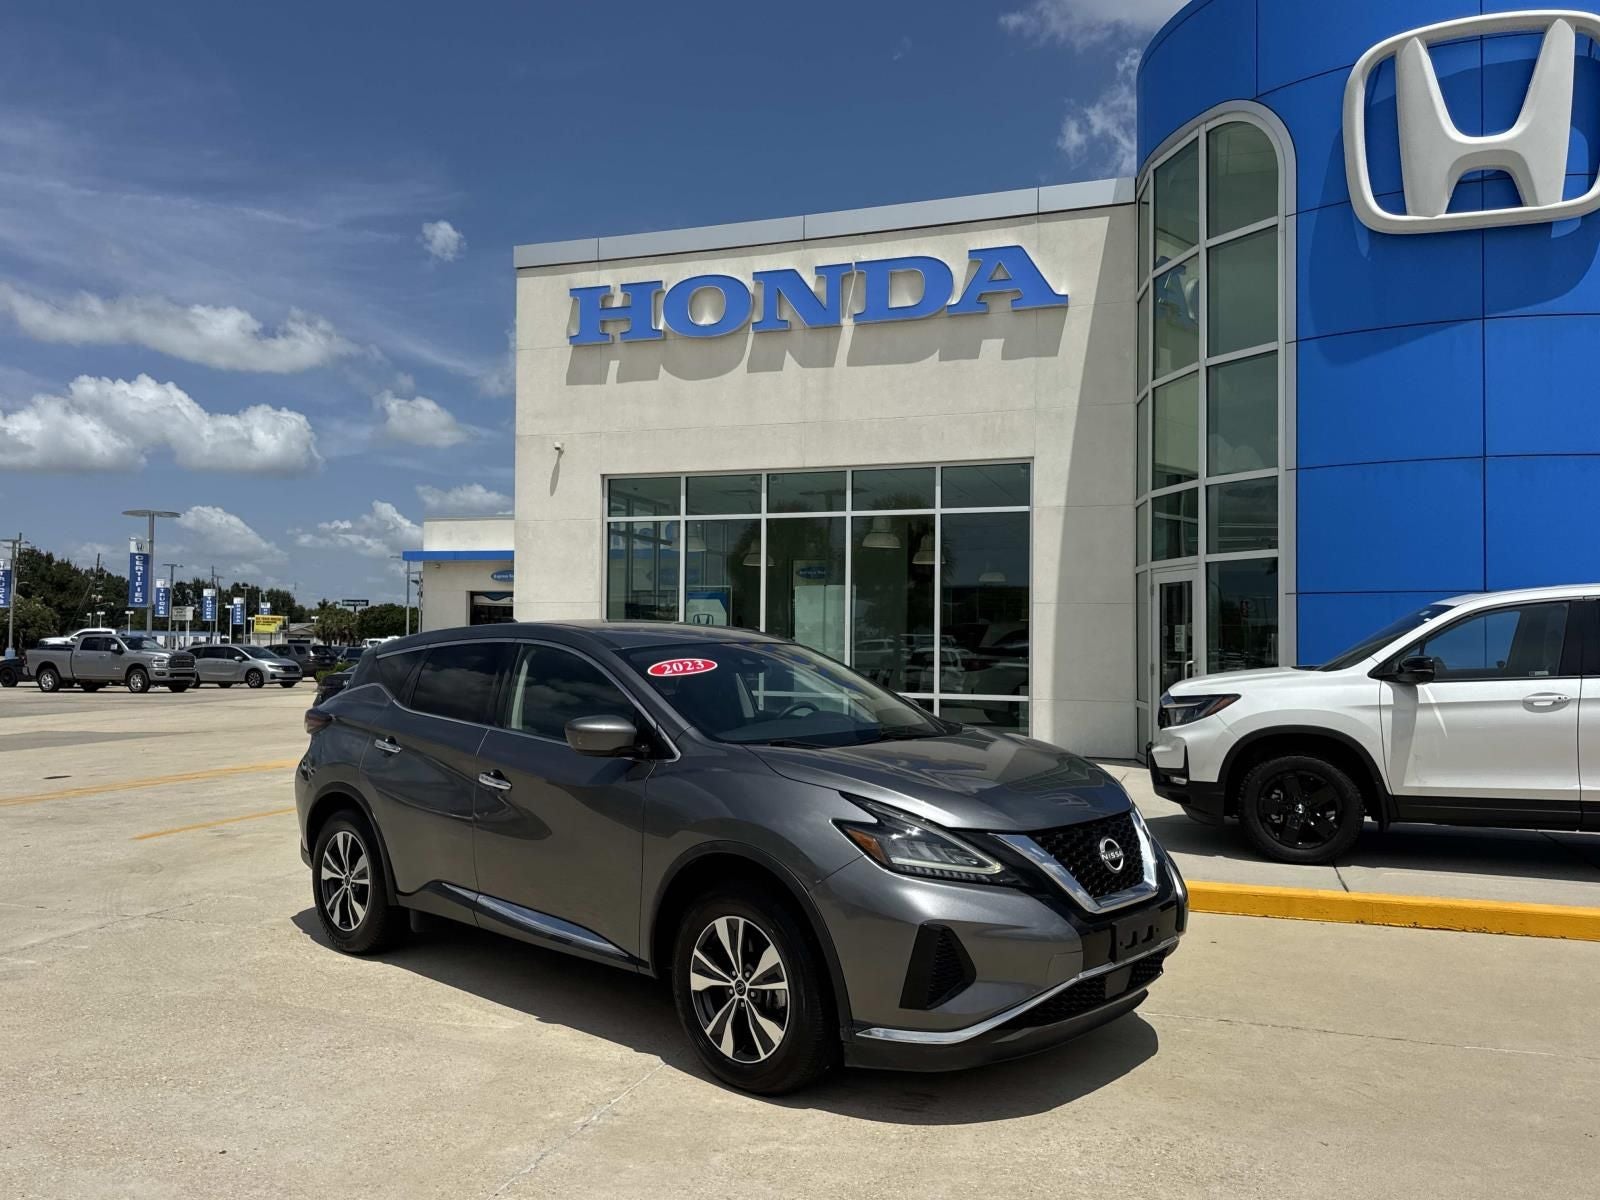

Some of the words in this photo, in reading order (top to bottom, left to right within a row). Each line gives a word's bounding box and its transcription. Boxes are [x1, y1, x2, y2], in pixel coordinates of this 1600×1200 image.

[569, 245, 1069, 346] HONDA
[134, 555, 144, 603] CERTIFIED
[158, 588, 166, 615] TRUCKS
[661, 660, 705, 674] 2023
